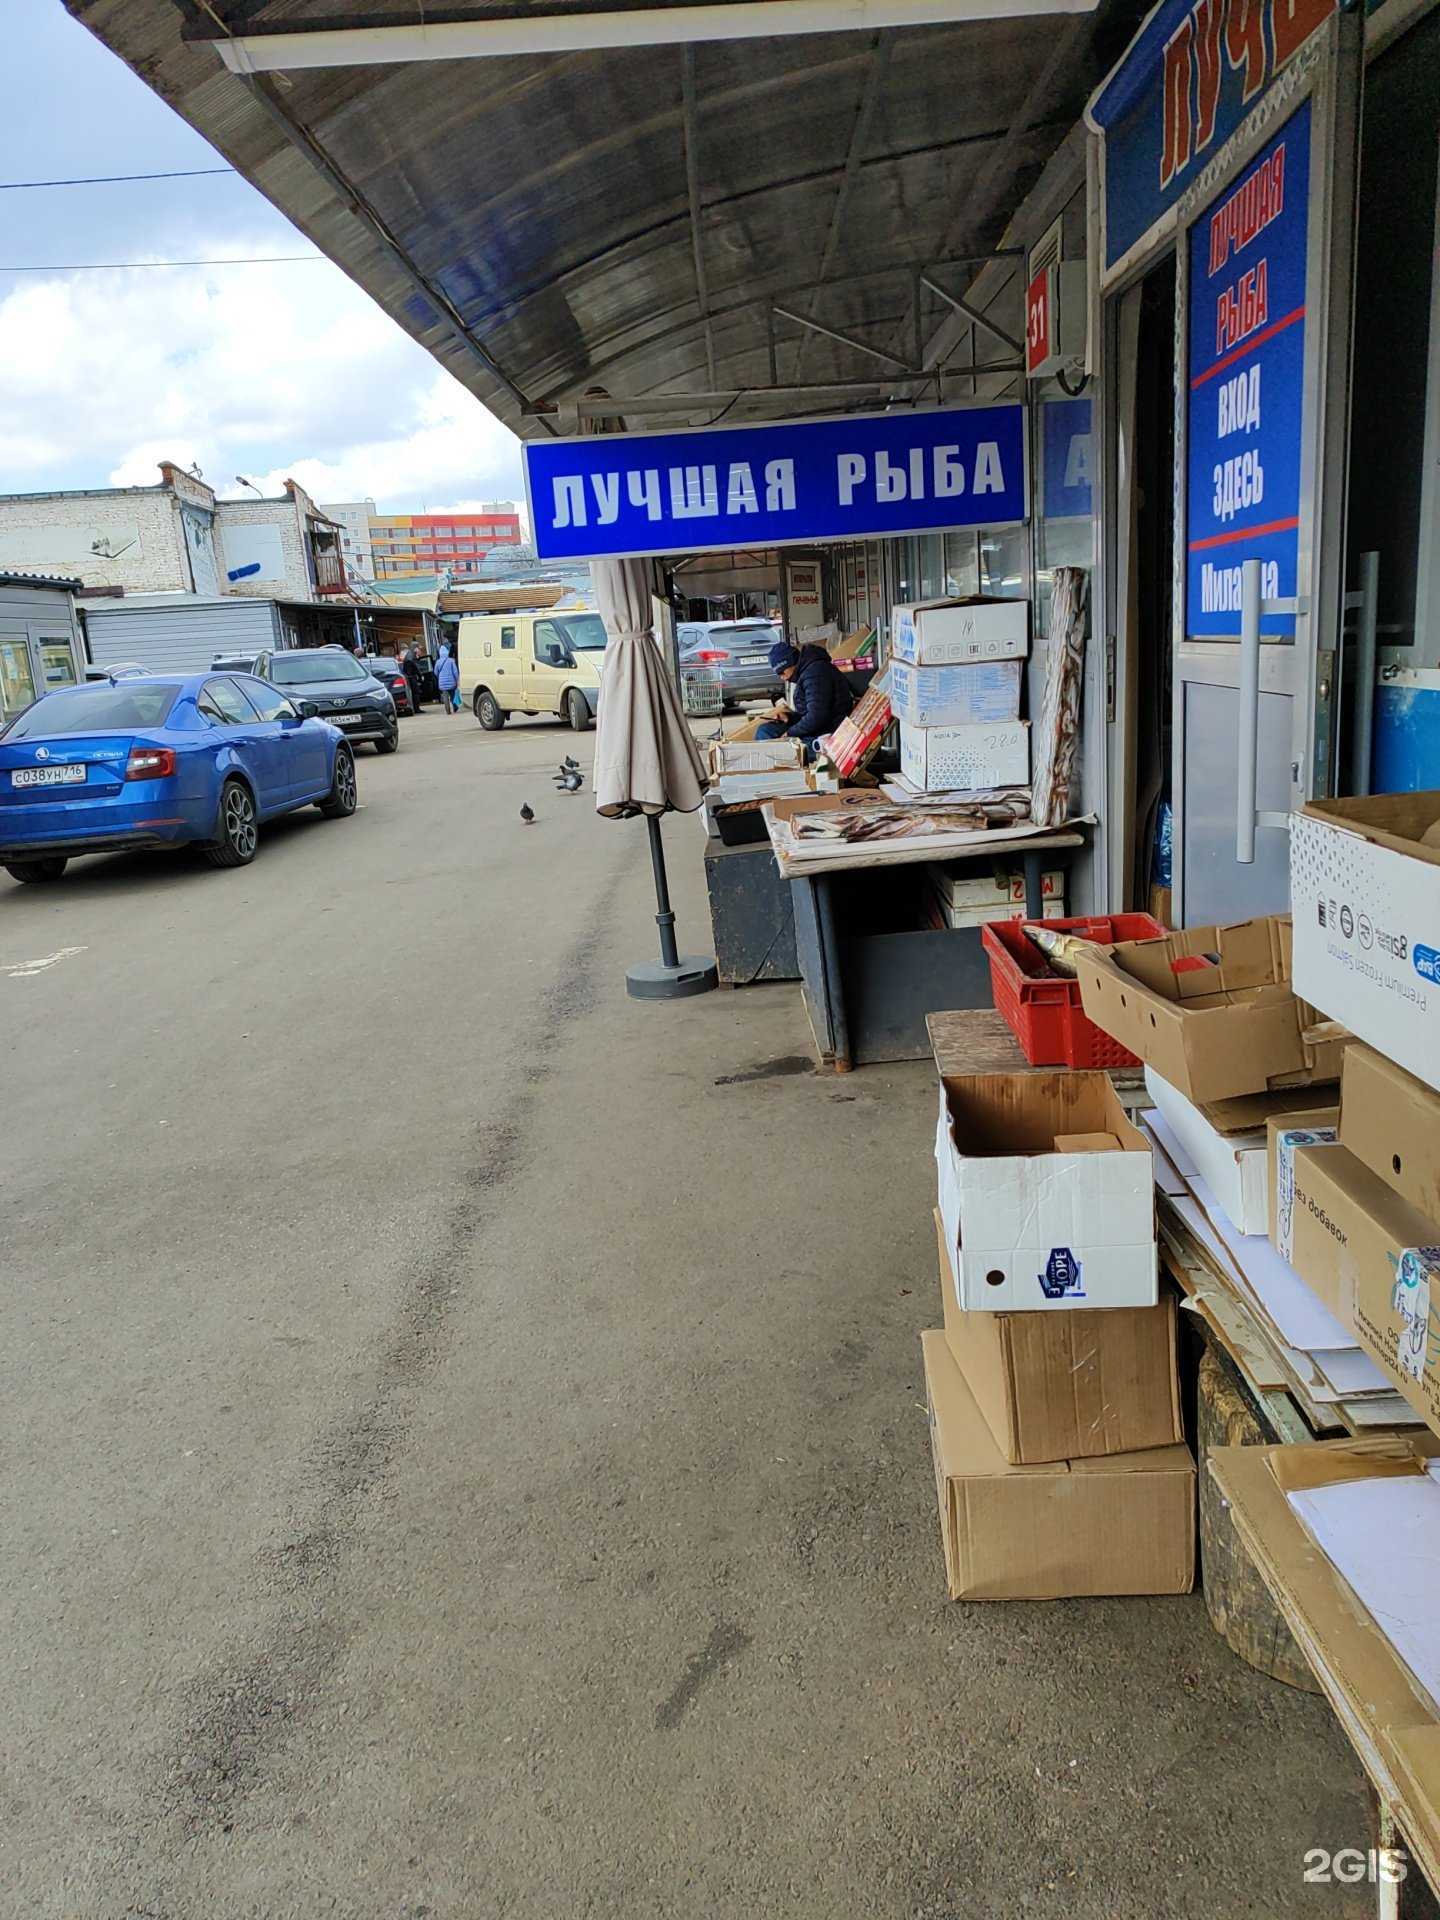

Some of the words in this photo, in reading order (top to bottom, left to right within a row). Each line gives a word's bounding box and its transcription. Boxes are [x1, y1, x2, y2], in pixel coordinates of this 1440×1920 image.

[1208, 142, 1285, 278] ЛУЧШАЯ
[1030, 295, 1045, 349] 31
[1216, 257, 1268, 356] РЫБА
[1217, 363, 1261, 439] ВХОД
[551, 457, 797, 529] ЛУЧШАЯ
[837, 441, 1006, 506] РЫБА
[1213, 449, 1264, 522] ЗДЕСЬ
[1308, 1195, 1348, 1248] добавок
